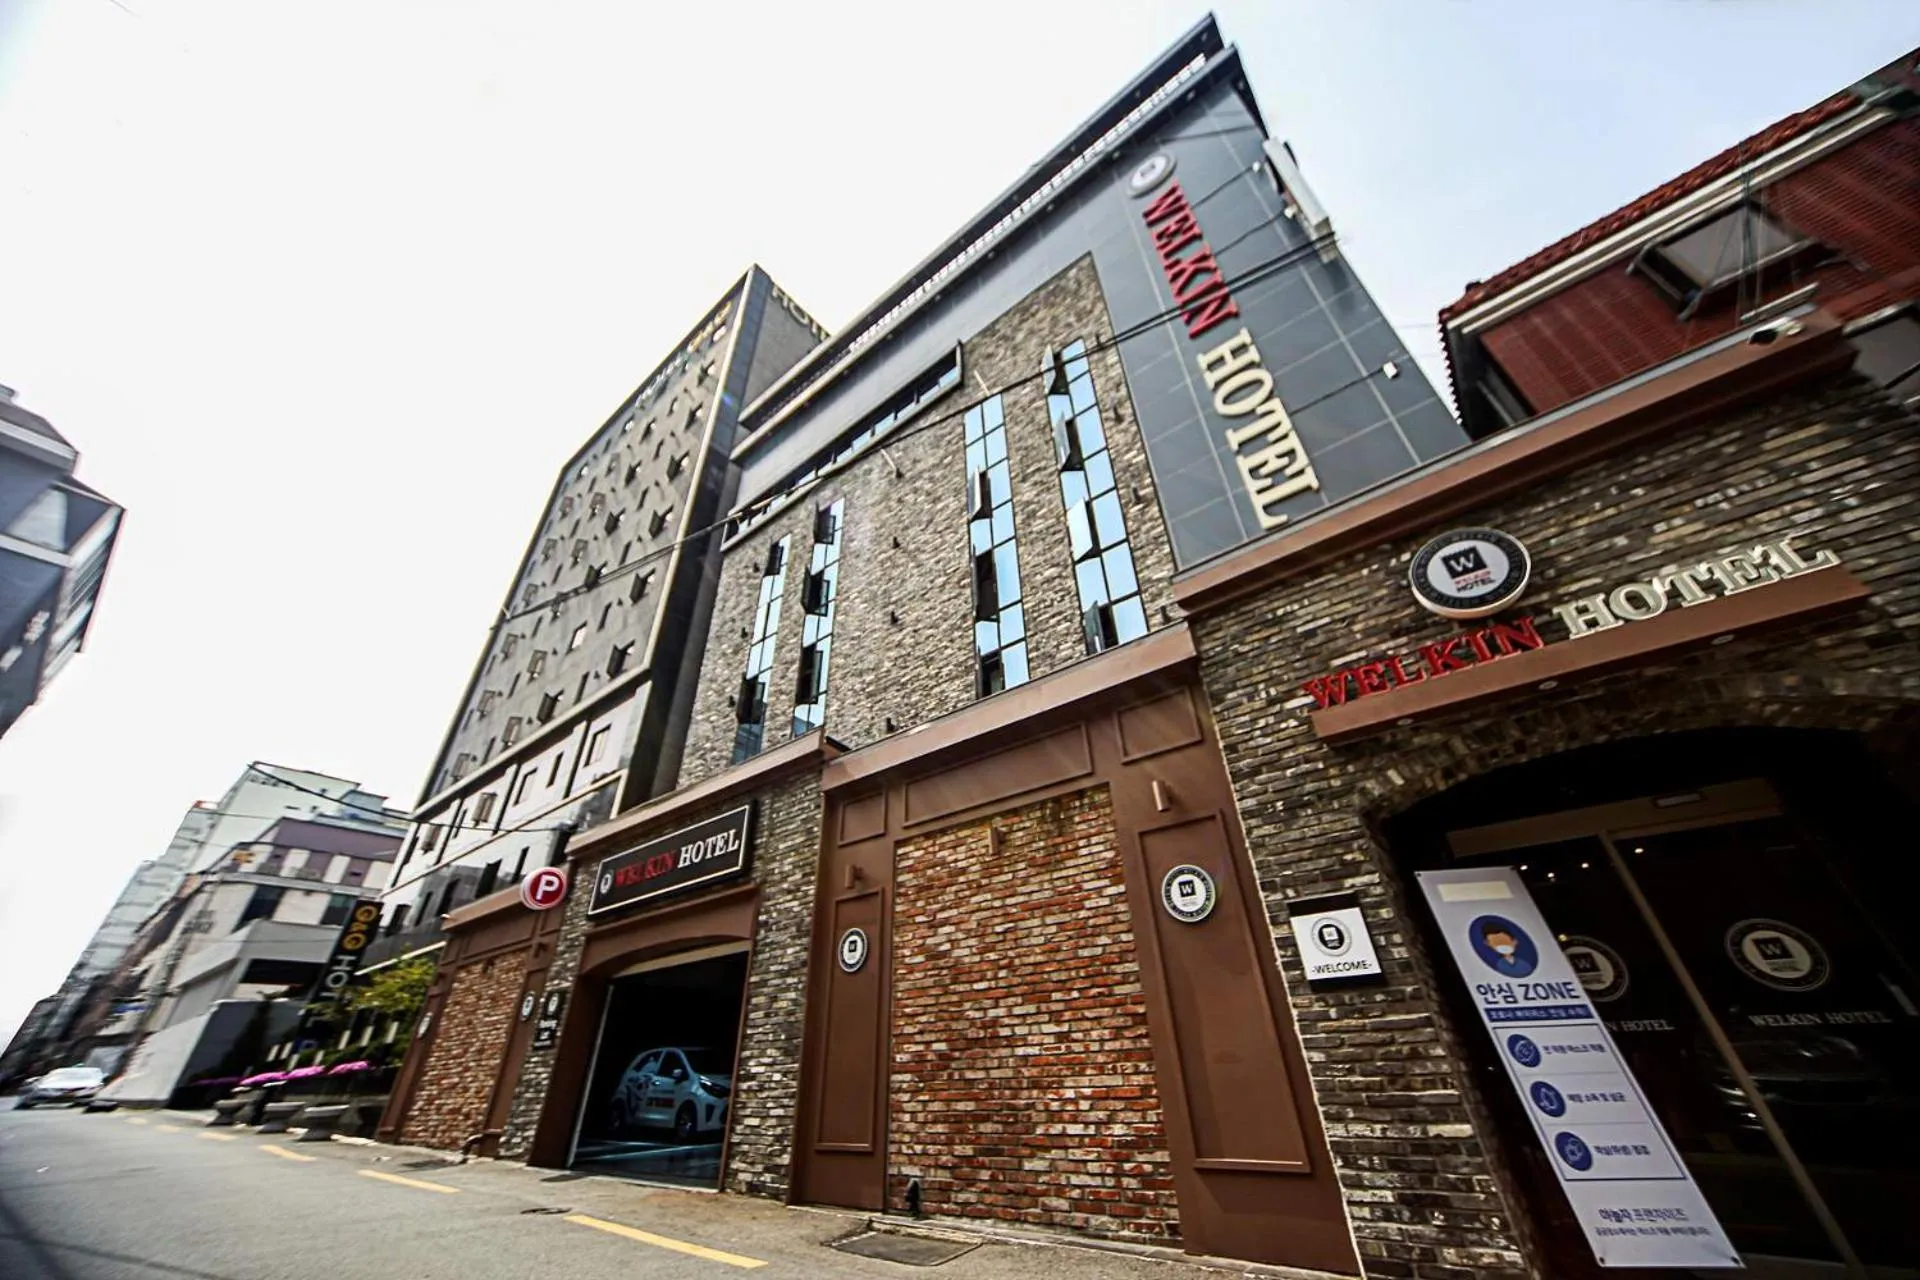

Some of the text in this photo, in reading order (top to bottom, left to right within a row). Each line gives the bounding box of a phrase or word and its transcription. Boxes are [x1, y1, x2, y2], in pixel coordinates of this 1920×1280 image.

[1142, 180, 1320, 530] WELKIN HOTEL
[1302, 534, 1842, 711] WELKIN HOTEL
[615, 829, 740, 887] WELKIN HOTEL
[535, 874, 560, 901] P
[1476, 982, 1581, 1004] 안심 ZONE
[1620, 1018, 1677, 1031] HOTEL
[1747, 1010, 1893, 1027] WELKIN HOTEL
